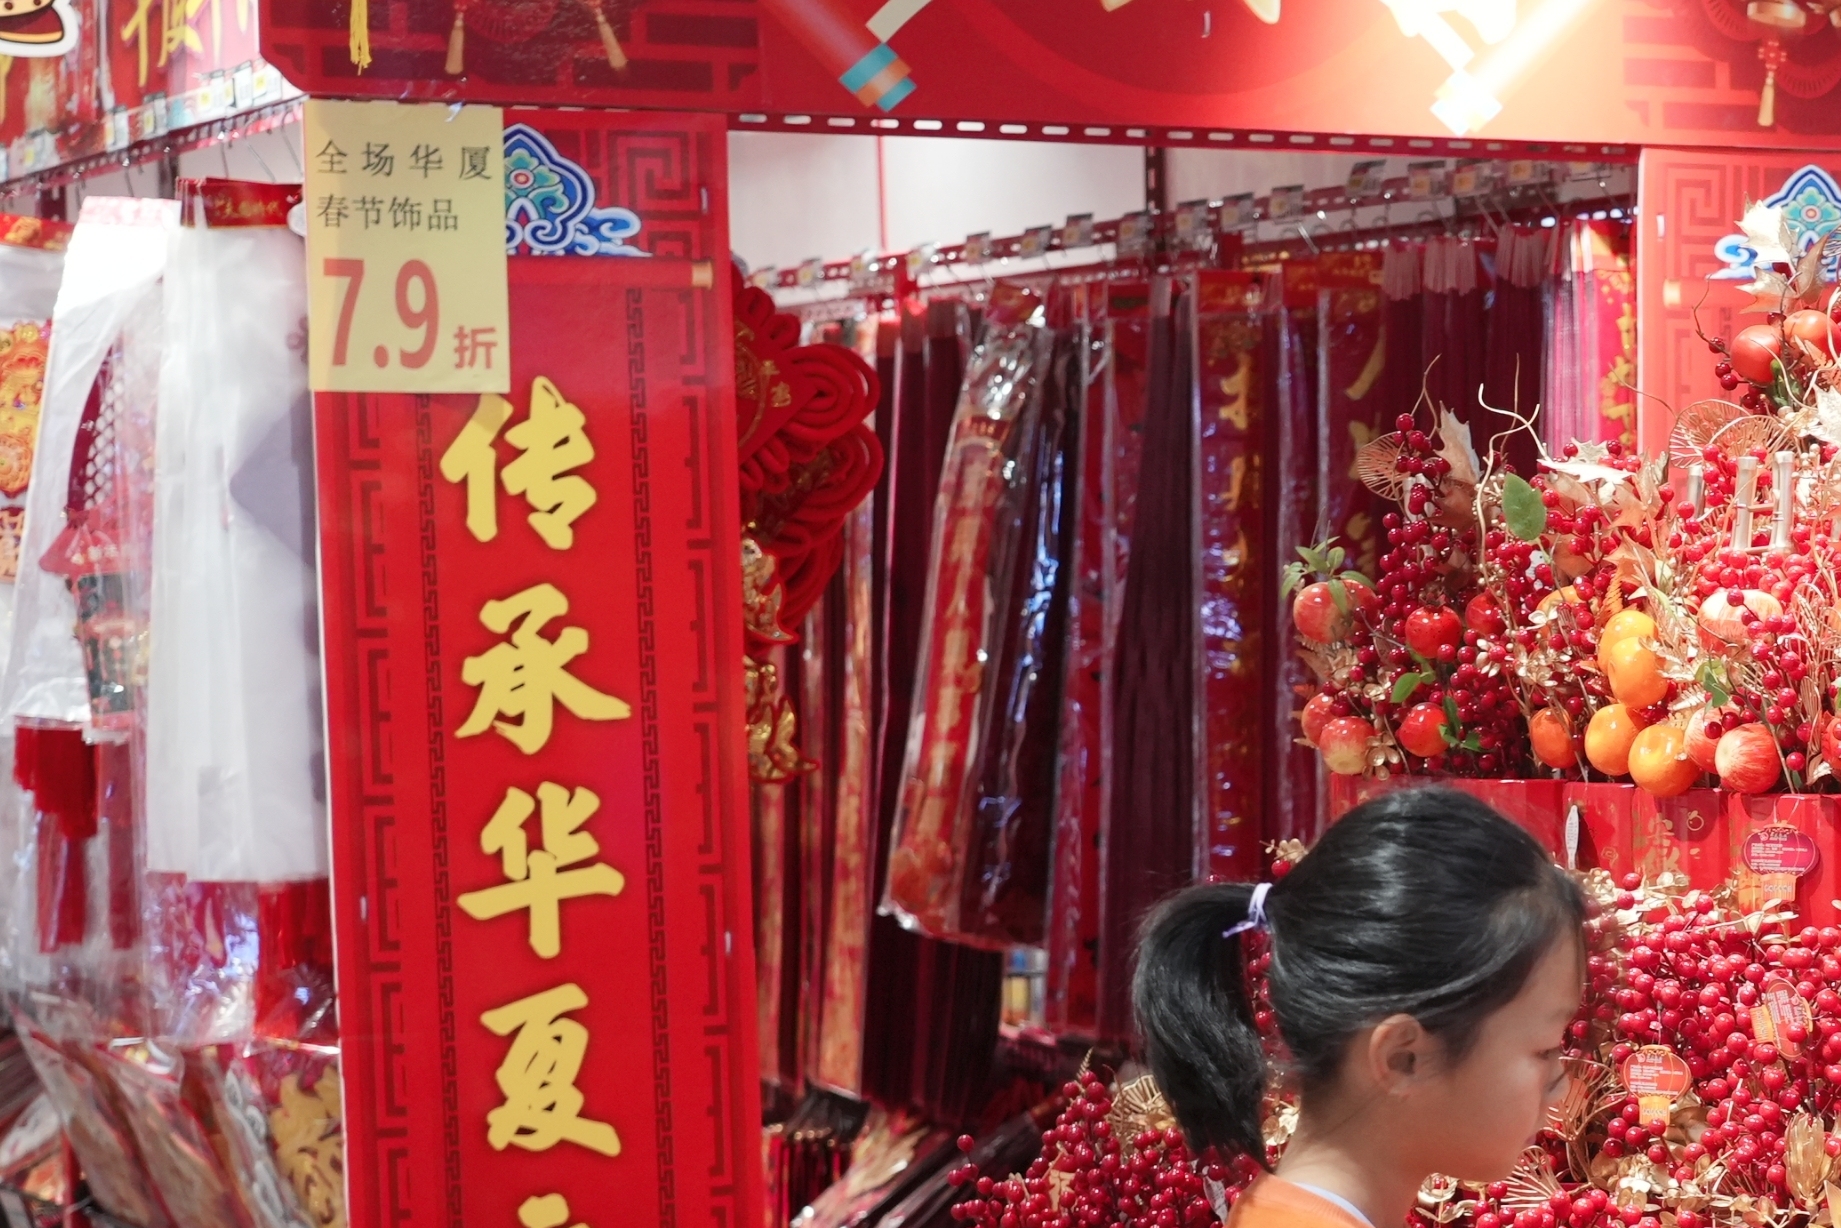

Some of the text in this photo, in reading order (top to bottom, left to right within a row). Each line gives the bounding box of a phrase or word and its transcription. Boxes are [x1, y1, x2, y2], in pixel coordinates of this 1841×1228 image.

[315, 138, 493, 181] 全场华厦
[316, 192, 459, 232] 春节饰品
